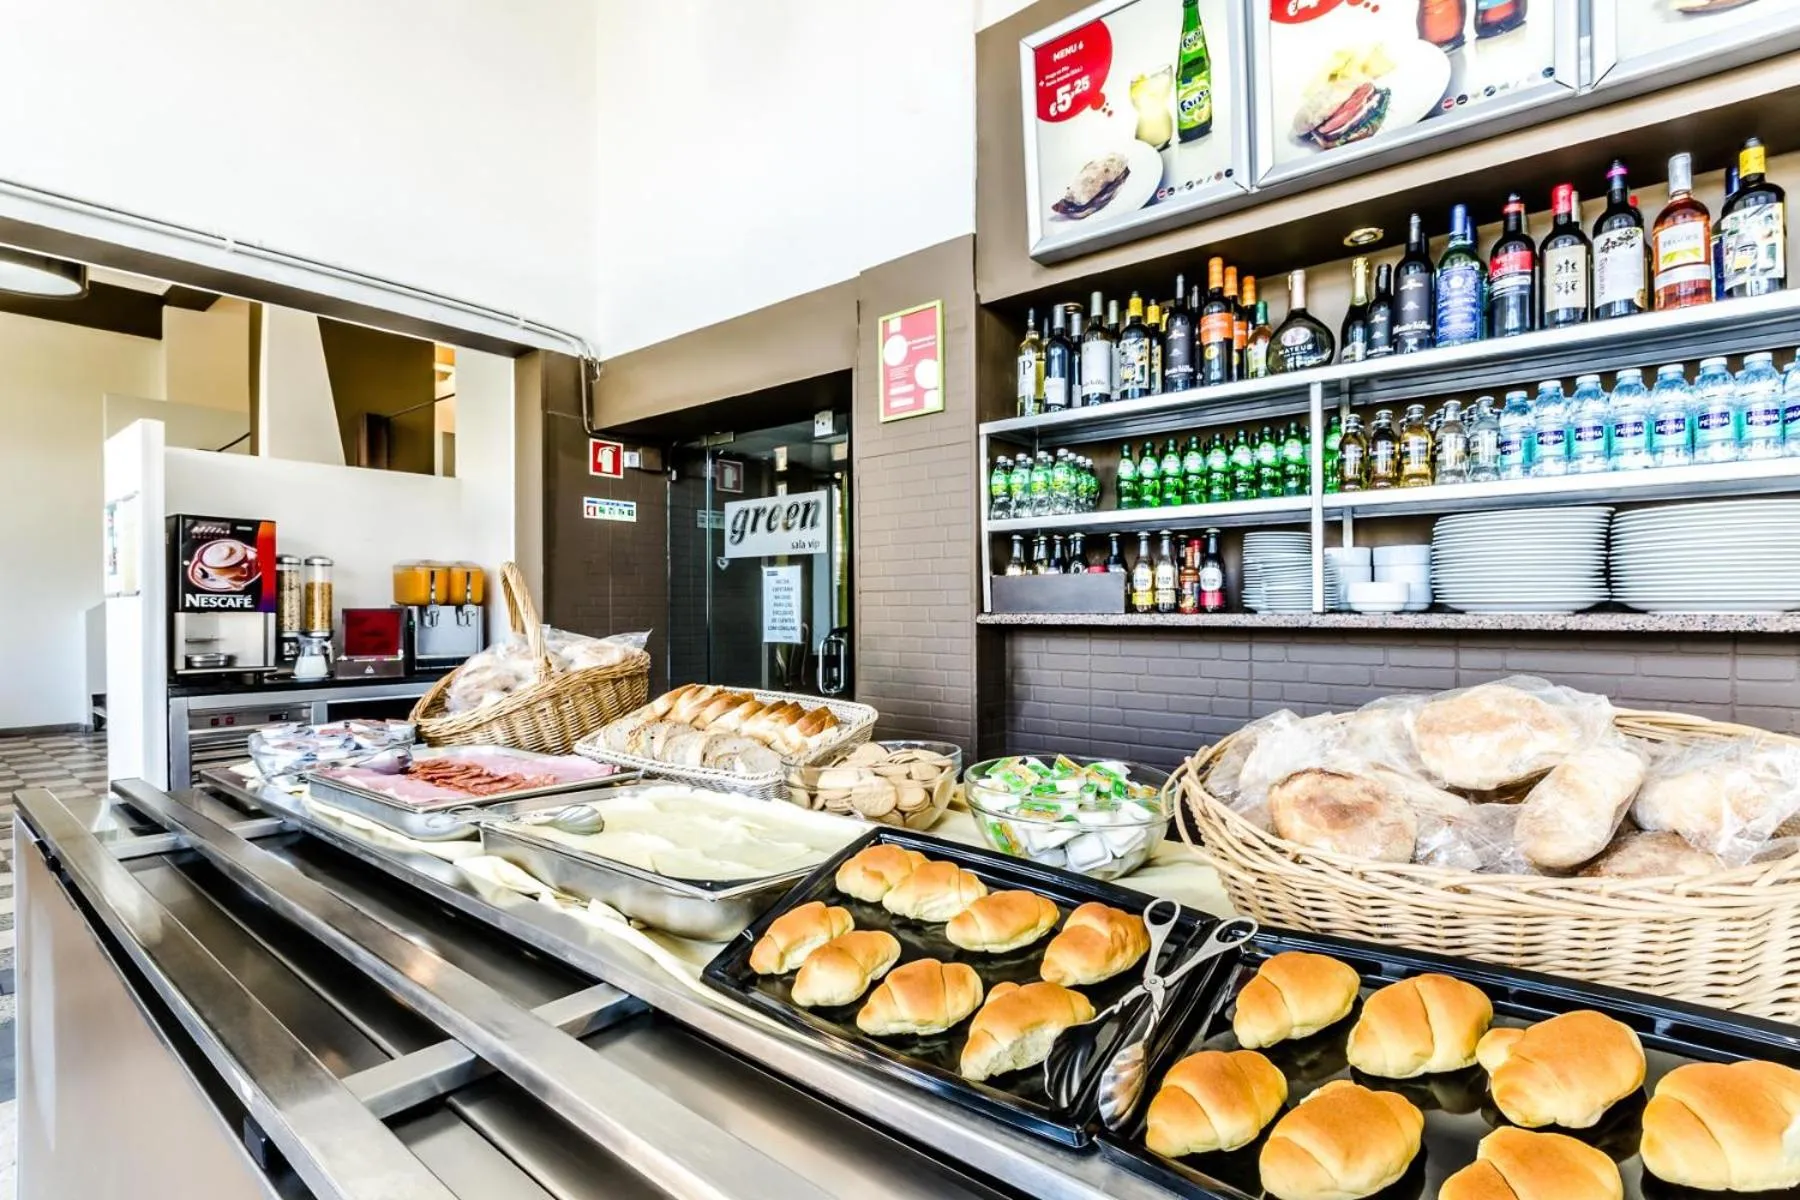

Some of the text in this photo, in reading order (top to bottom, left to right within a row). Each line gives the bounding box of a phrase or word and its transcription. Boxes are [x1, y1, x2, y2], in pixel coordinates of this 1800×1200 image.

[1053, 40, 1085, 62] MENU 6
[1048, 75, 1091, 117] €5,25
[1180, 88, 1211, 113] Fanta
[729, 499, 822, 546] green
[791, 539, 821, 550] sala vip
[184, 593, 254, 609] NESCAFÉ
